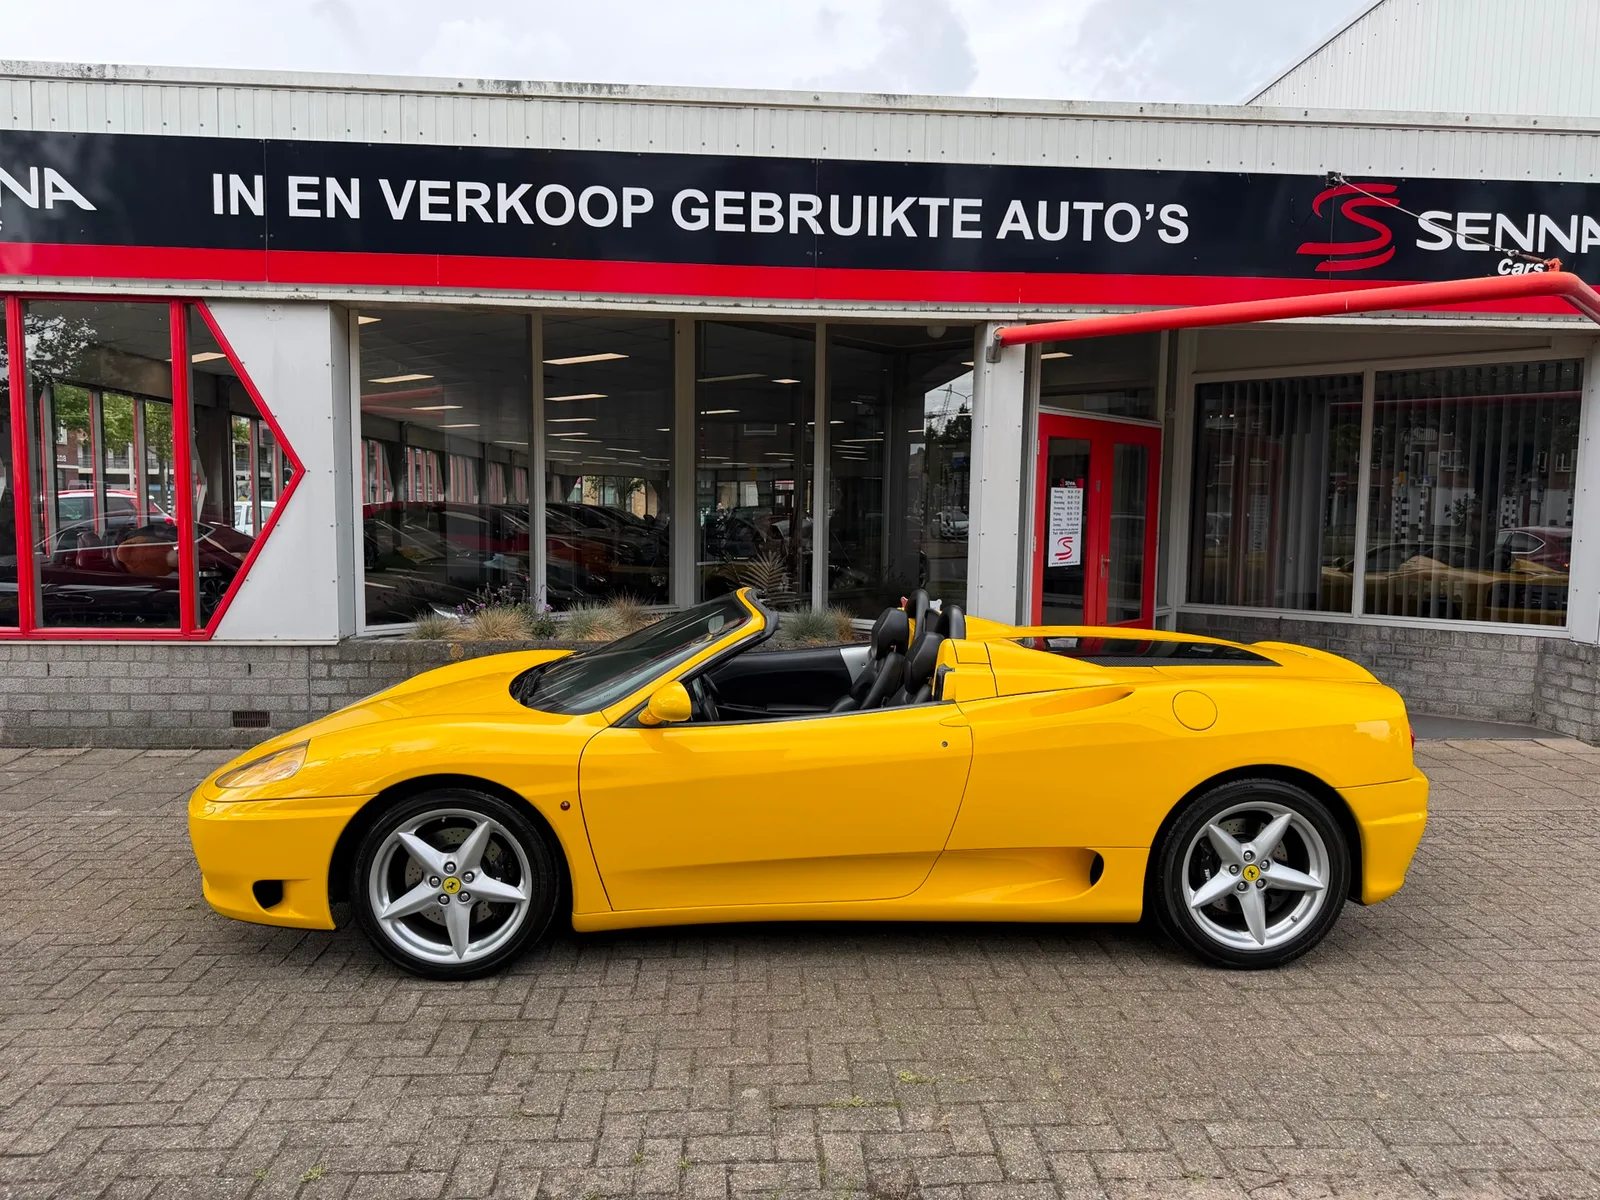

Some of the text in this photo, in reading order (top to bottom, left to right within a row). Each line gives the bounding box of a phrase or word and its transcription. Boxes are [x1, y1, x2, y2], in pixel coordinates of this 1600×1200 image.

[212, 173, 1189, 244] IN EN VERKOOP GEBRUIKTE AUTO’S
[1497, 258, 1545, 276] Cars
